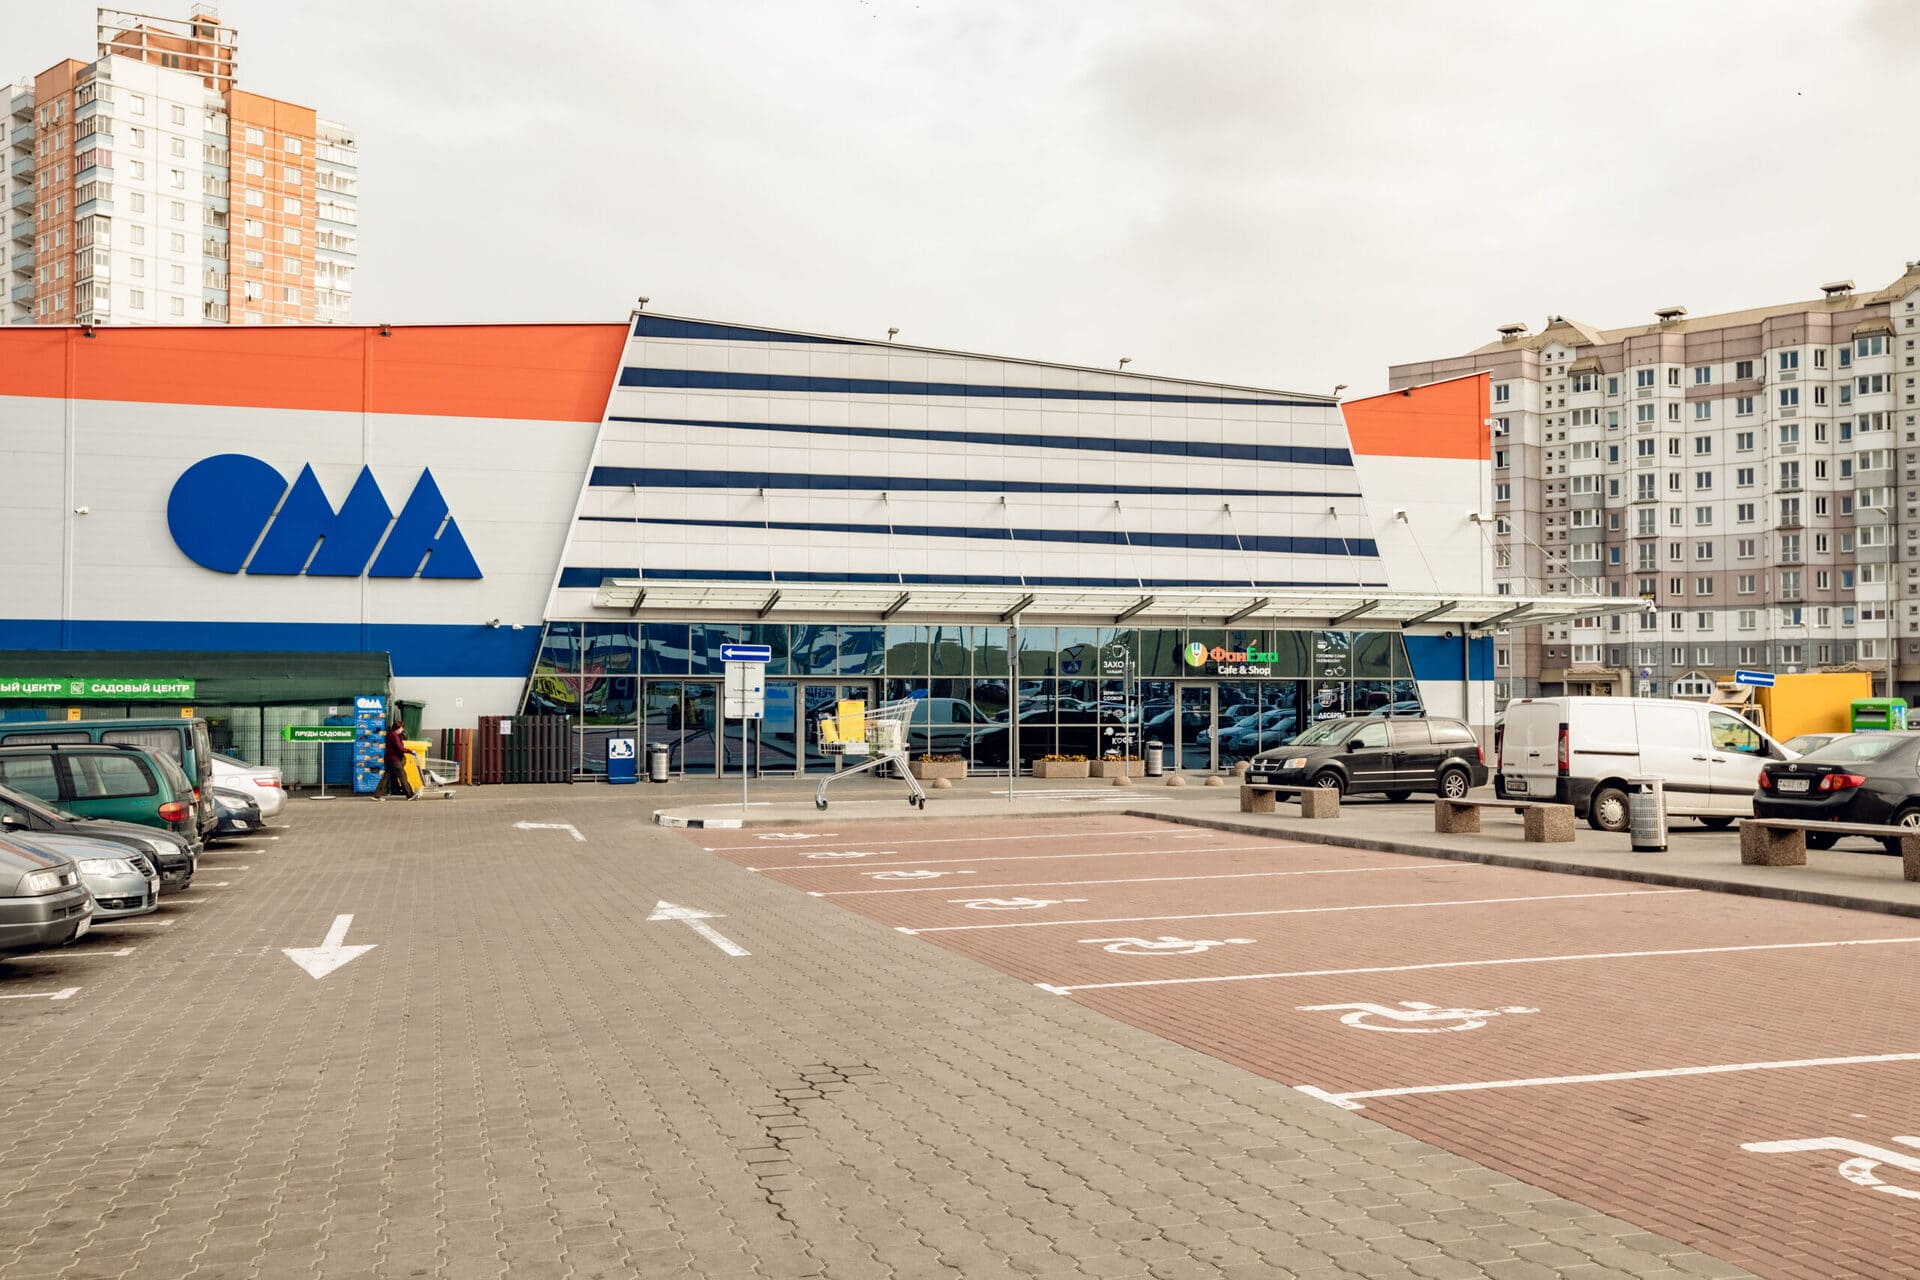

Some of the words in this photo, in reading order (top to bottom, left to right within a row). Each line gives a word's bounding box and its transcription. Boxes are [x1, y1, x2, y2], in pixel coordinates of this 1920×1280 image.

[1218, 665, 1239, 675] Cafe
[1239, 665, 1248, 675] &
[1248, 665, 1271, 677] Shop
[22, 683, 62, 693] ЦЕНТР
[91, 682, 150, 693] САДОВЫЙ
[152, 683, 190, 694] ЦЕНТР
[294, 730, 319, 738] ПРУДЫ
